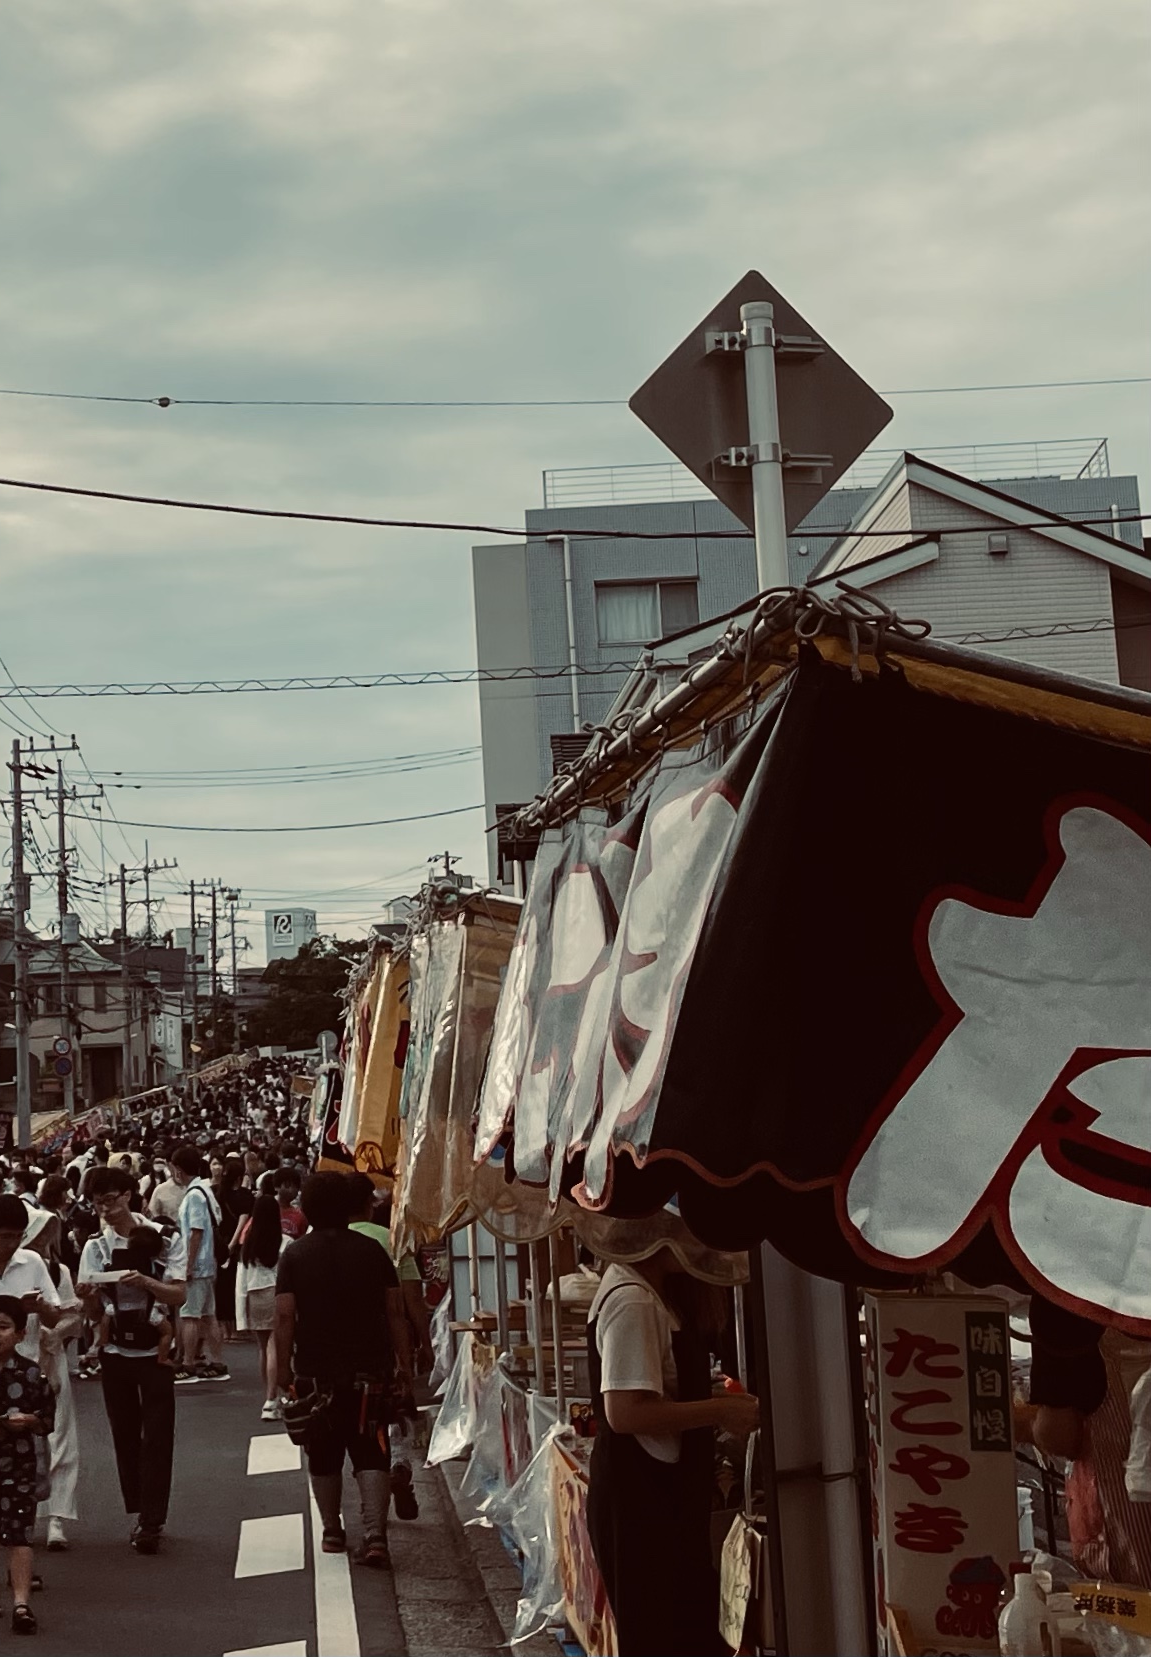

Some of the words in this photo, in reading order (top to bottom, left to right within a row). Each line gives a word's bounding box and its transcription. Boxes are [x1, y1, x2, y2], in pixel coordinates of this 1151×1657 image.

[882, 1327, 971, 1554] たこやき
[968, 1322, 1008, 1443] 味自慢
